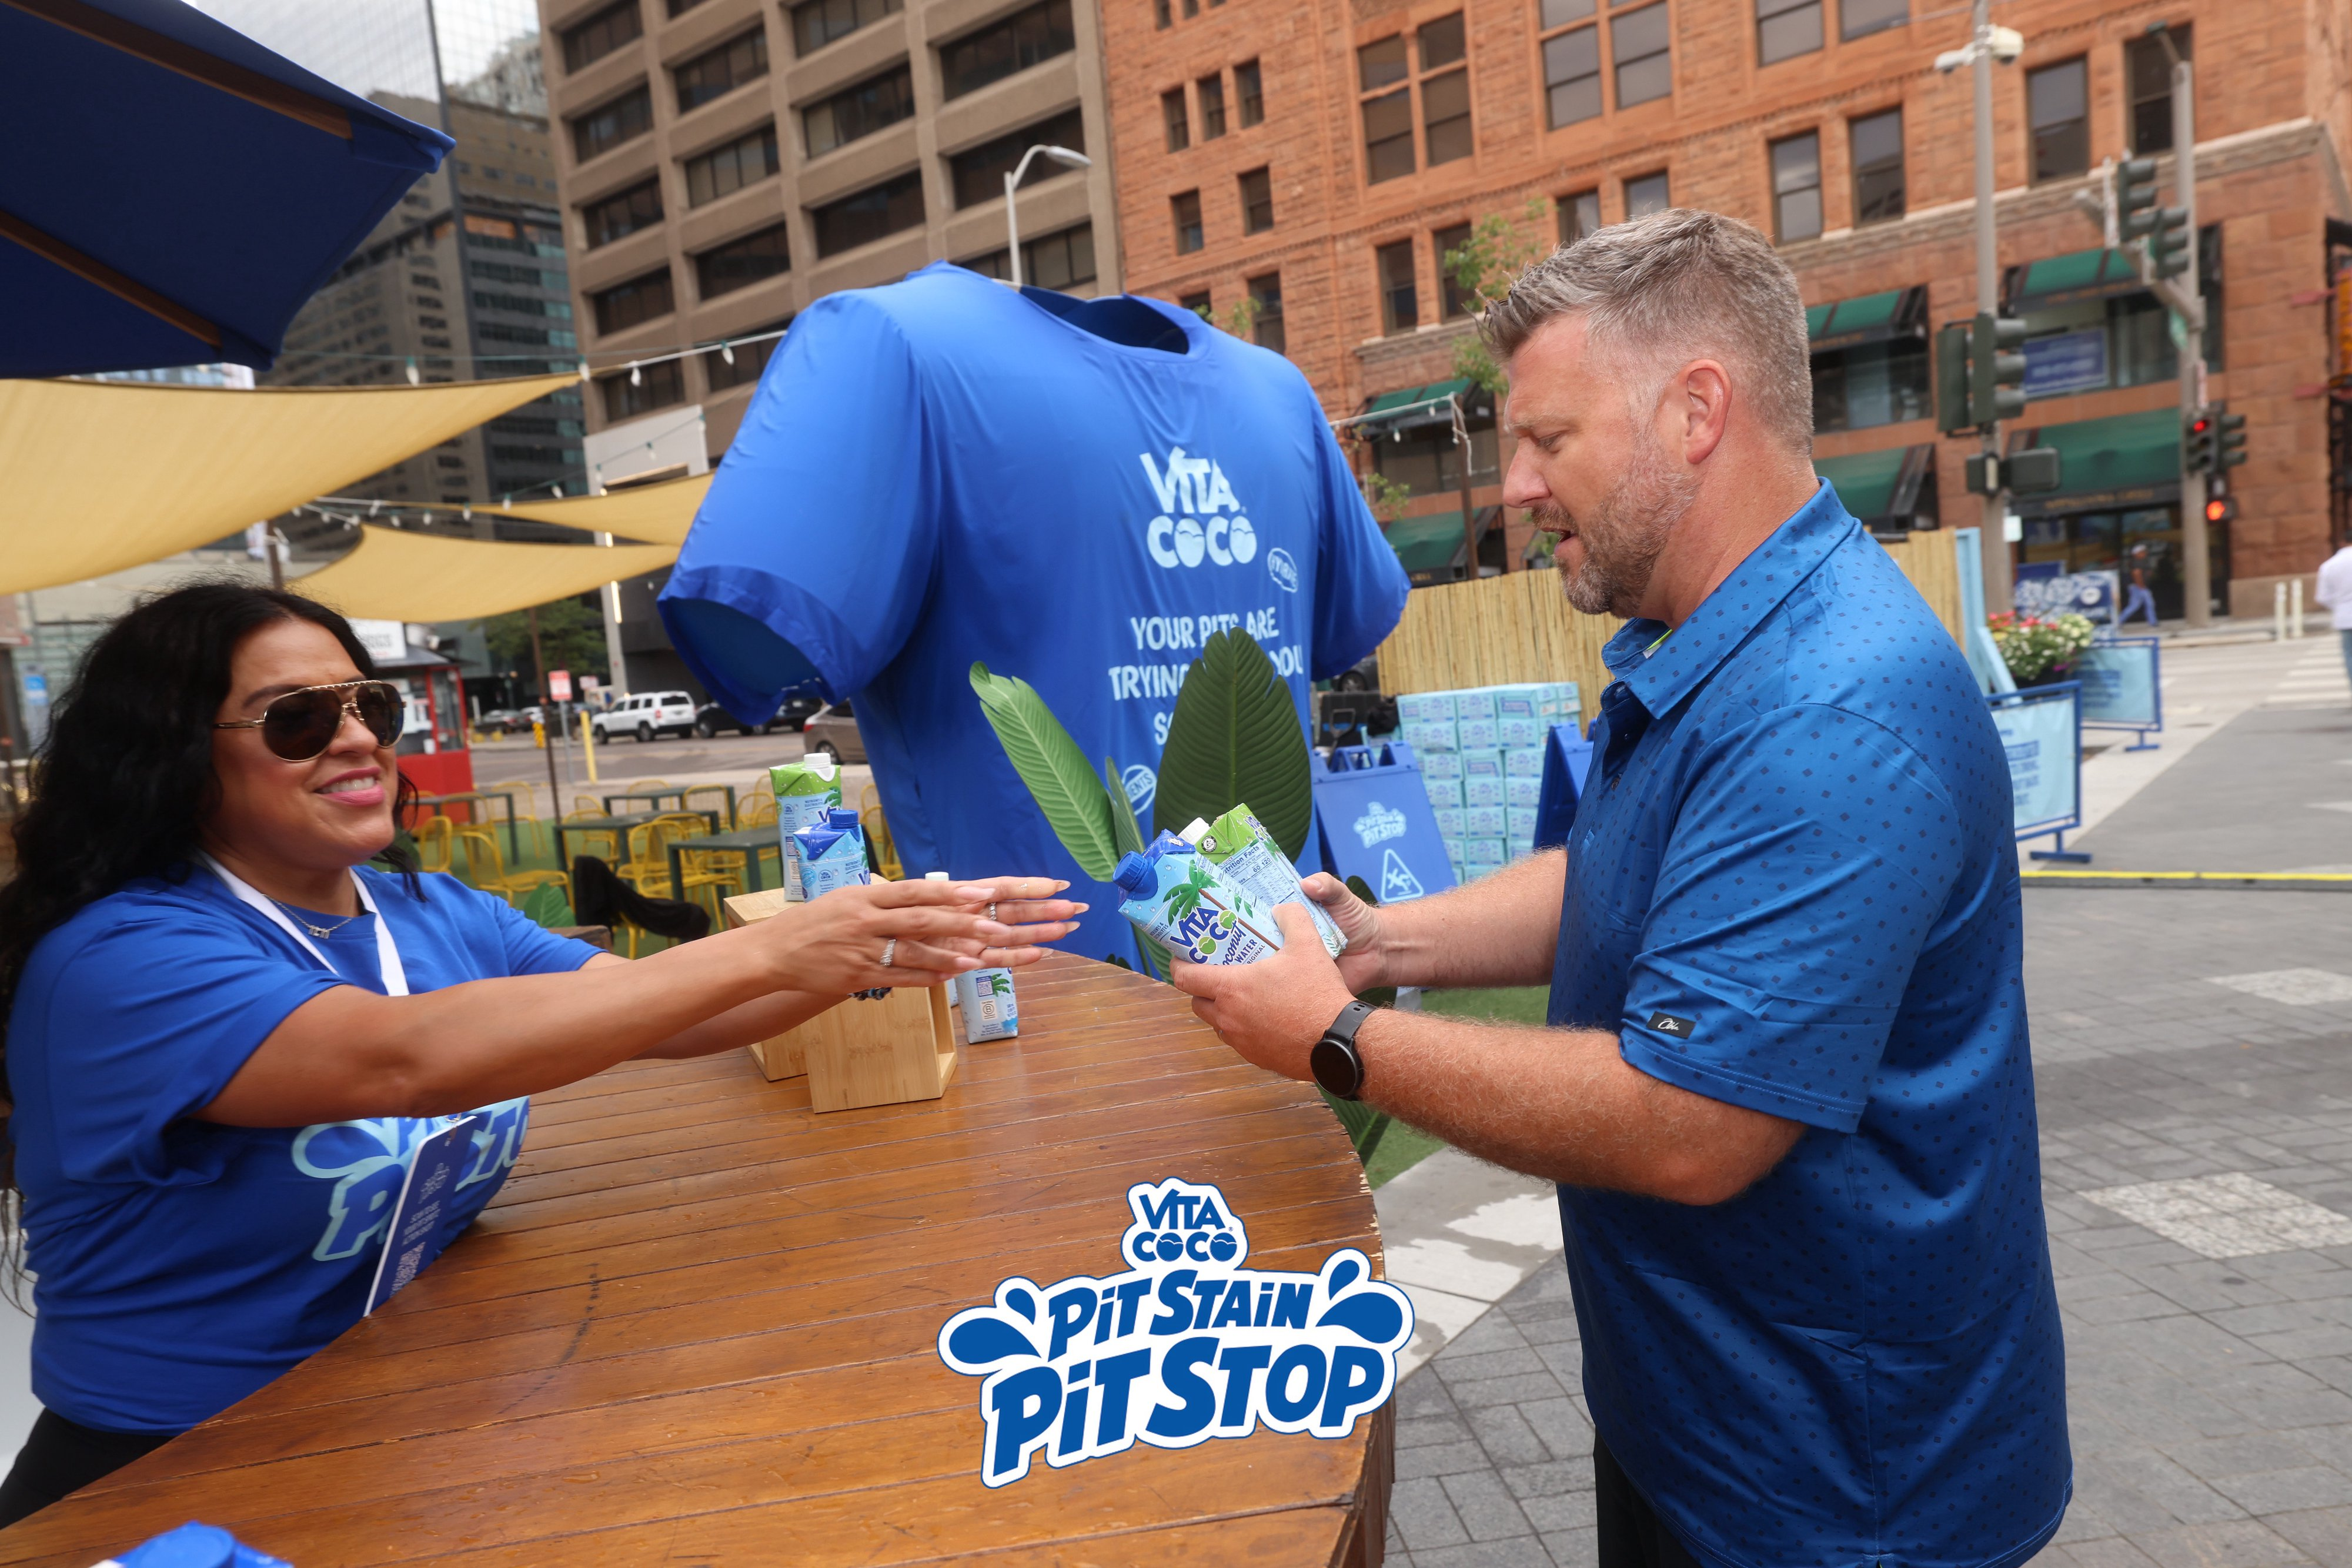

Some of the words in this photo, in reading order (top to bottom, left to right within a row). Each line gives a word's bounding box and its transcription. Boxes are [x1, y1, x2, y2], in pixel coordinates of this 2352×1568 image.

[1140, 446, 1241, 514] VITA
[1147, 515, 1257, 569] COCO
[1130, 616, 1197, 651] YOUR
[1246, 606, 1280, 641] ARE
[1224, 857, 1244, 874] trition
[1244, 845, 1259, 858] Facts
[1262, 857, 1271, 866] 120
[1169, 907, 1220, 947] VITA
[1214, 919, 1247, 965] oconut
[1234, 938, 1258, 964] WATER
[1247, 944, 1266, 965] RIGINAL
